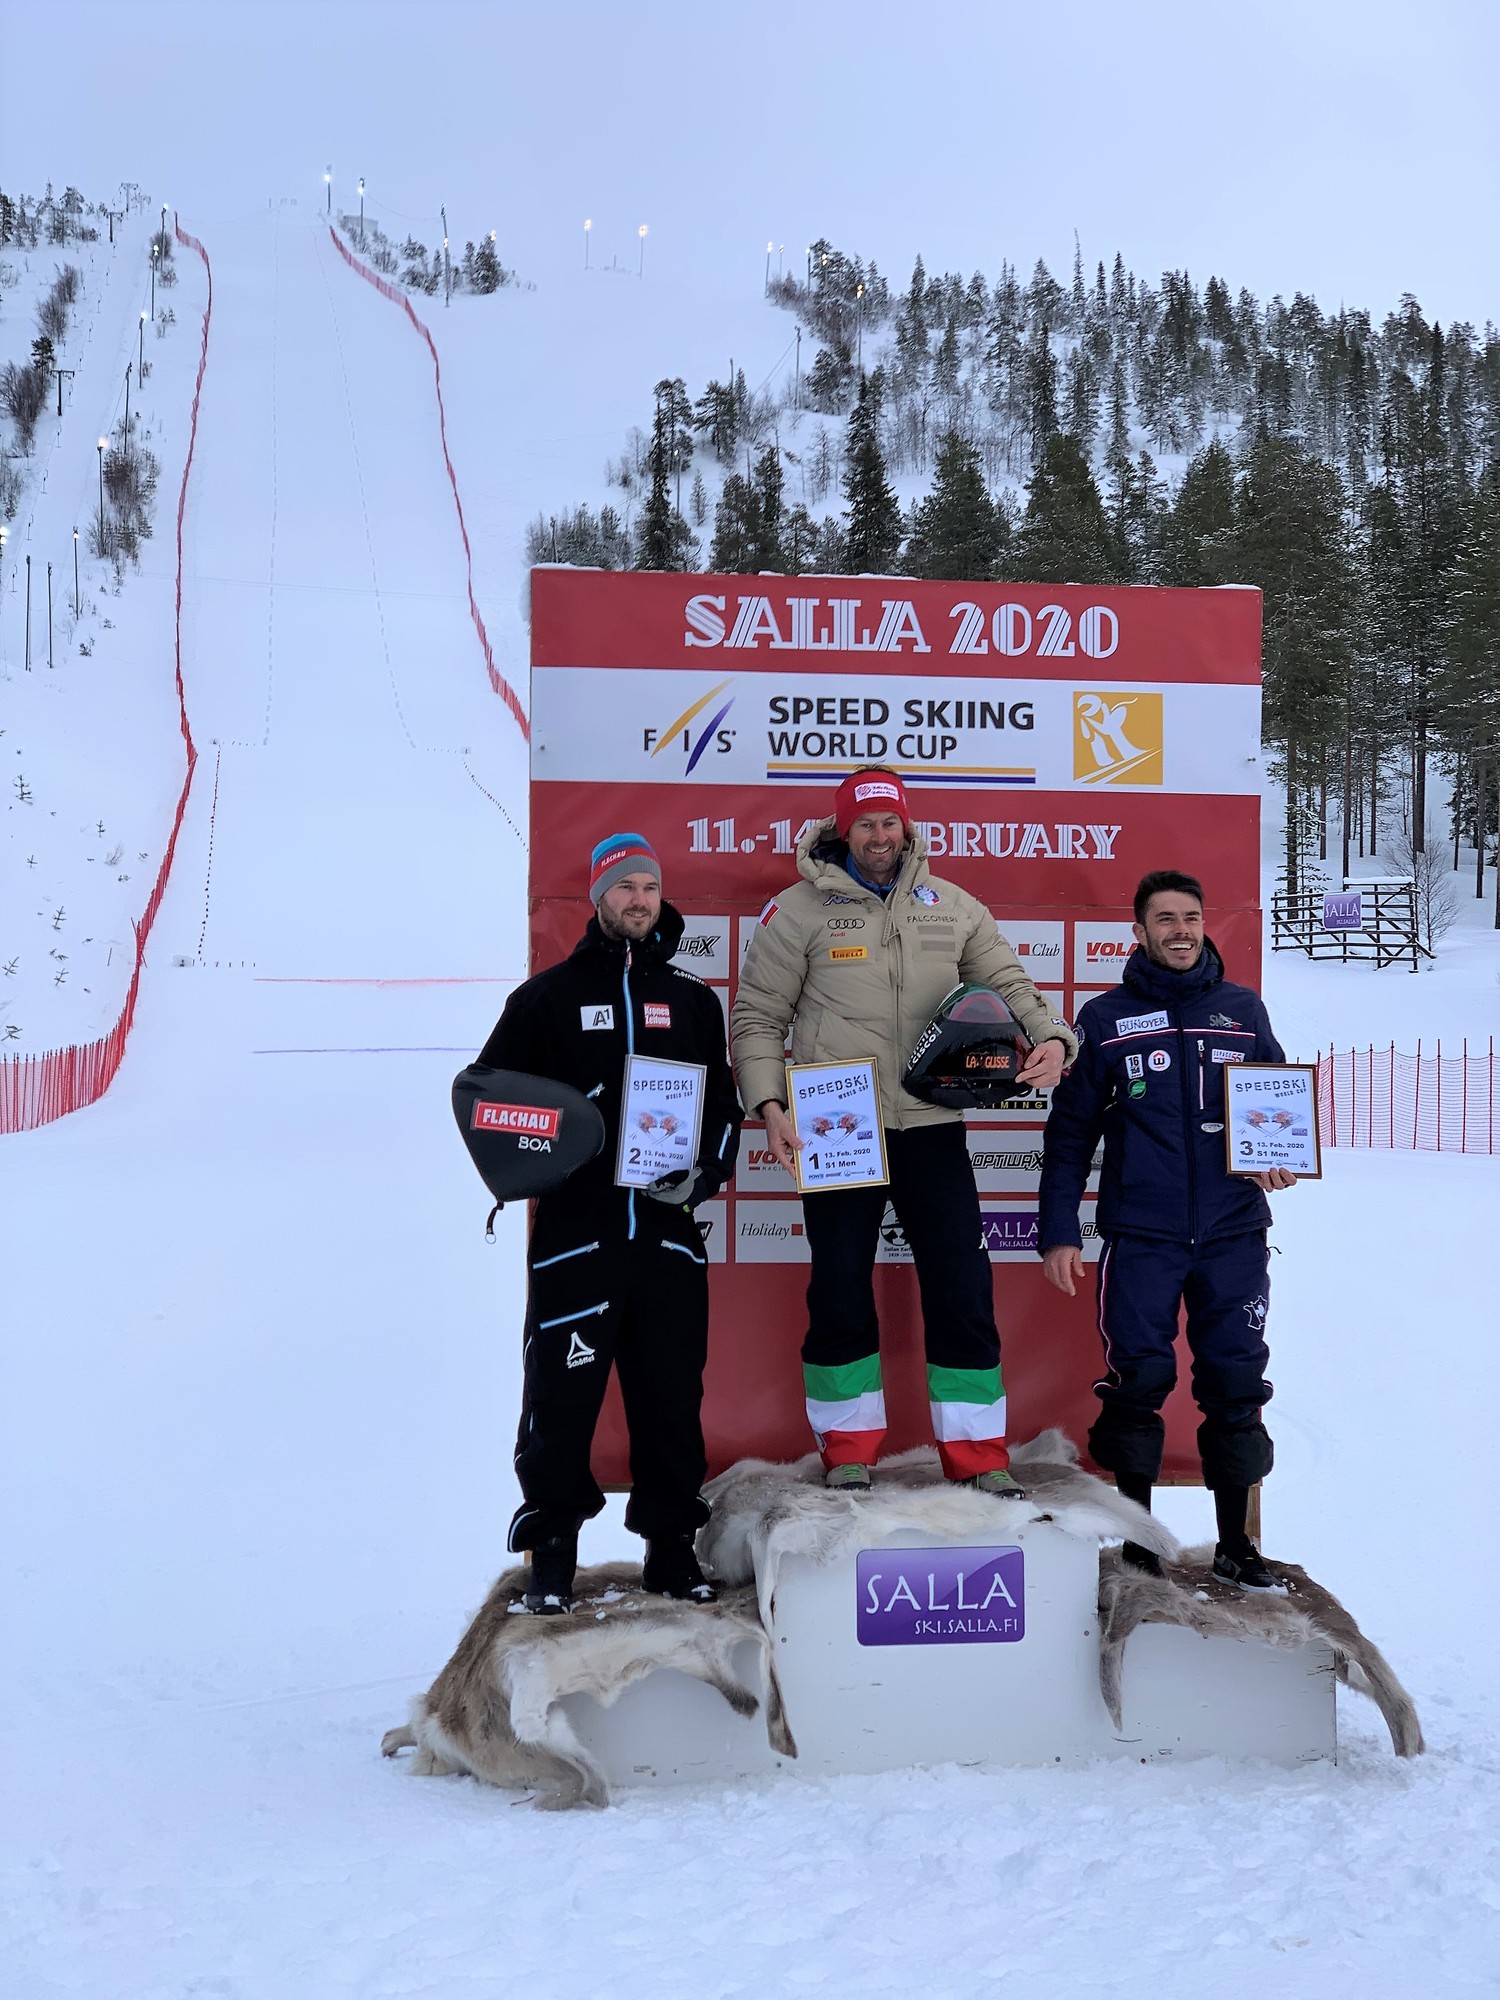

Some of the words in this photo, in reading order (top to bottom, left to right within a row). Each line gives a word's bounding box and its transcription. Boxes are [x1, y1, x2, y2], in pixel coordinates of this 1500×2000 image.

[684, 594, 932, 653] SALLA
[948, 602, 1119, 659] 2020
[768, 696, 889, 725] SPEED
[903, 699, 1035, 730] SKIING
[768, 731, 887, 758] WORLD
[896, 734, 958, 760] CUP
[913, 820, 1122, 860] BRUARY
[1325, 903, 1359, 917] SALLA
[906, 914, 958, 923] FALCONERI
[1032, 943, 1061, 957] Club
[644, 1005, 670, 1017] Kronen
[645, 1014, 671, 1027] Zeitung
[1118, 1016, 1167, 1034] DUNOYER
[912, 1033, 937, 1064] cisco
[965, 1055, 979, 1069] LA
[1127, 1055, 1140, 1067] 16
[633, 1080, 694, 1092] SPEEDSKI
[799, 1074, 868, 1099] SPEEDSKI
[1235, 1078, 1307, 1093] SPEEDSKI
[992, 1101, 1043, 1109] IMING
[482, 1108, 550, 1131] FLACHAU
[518, 1136, 552, 1153] BOA
[836, 1149, 852, 1158] Feb.
[853, 1147, 871, 1156] 2020
[1239, 1140, 1254, 1156] 3
[628, 1147, 641, 1165] 2
[808, 1152, 820, 1170] 1
[971, 1150, 1044, 1171] OPTIWAX
[1270, 1150, 1289, 1158] Men
[654, 1160, 670, 1169] Men
[838, 1160, 856, 1168] Men
[740, 1222, 790, 1240] Holiday
[982, 1221, 1039, 1238] ALLA
[999, 1240, 1038, 1248] SKI.SALLA.
[866, 1573, 1017, 1614] SALLA
[914, 1618, 1018, 1635] SKI.SALLA.FI
